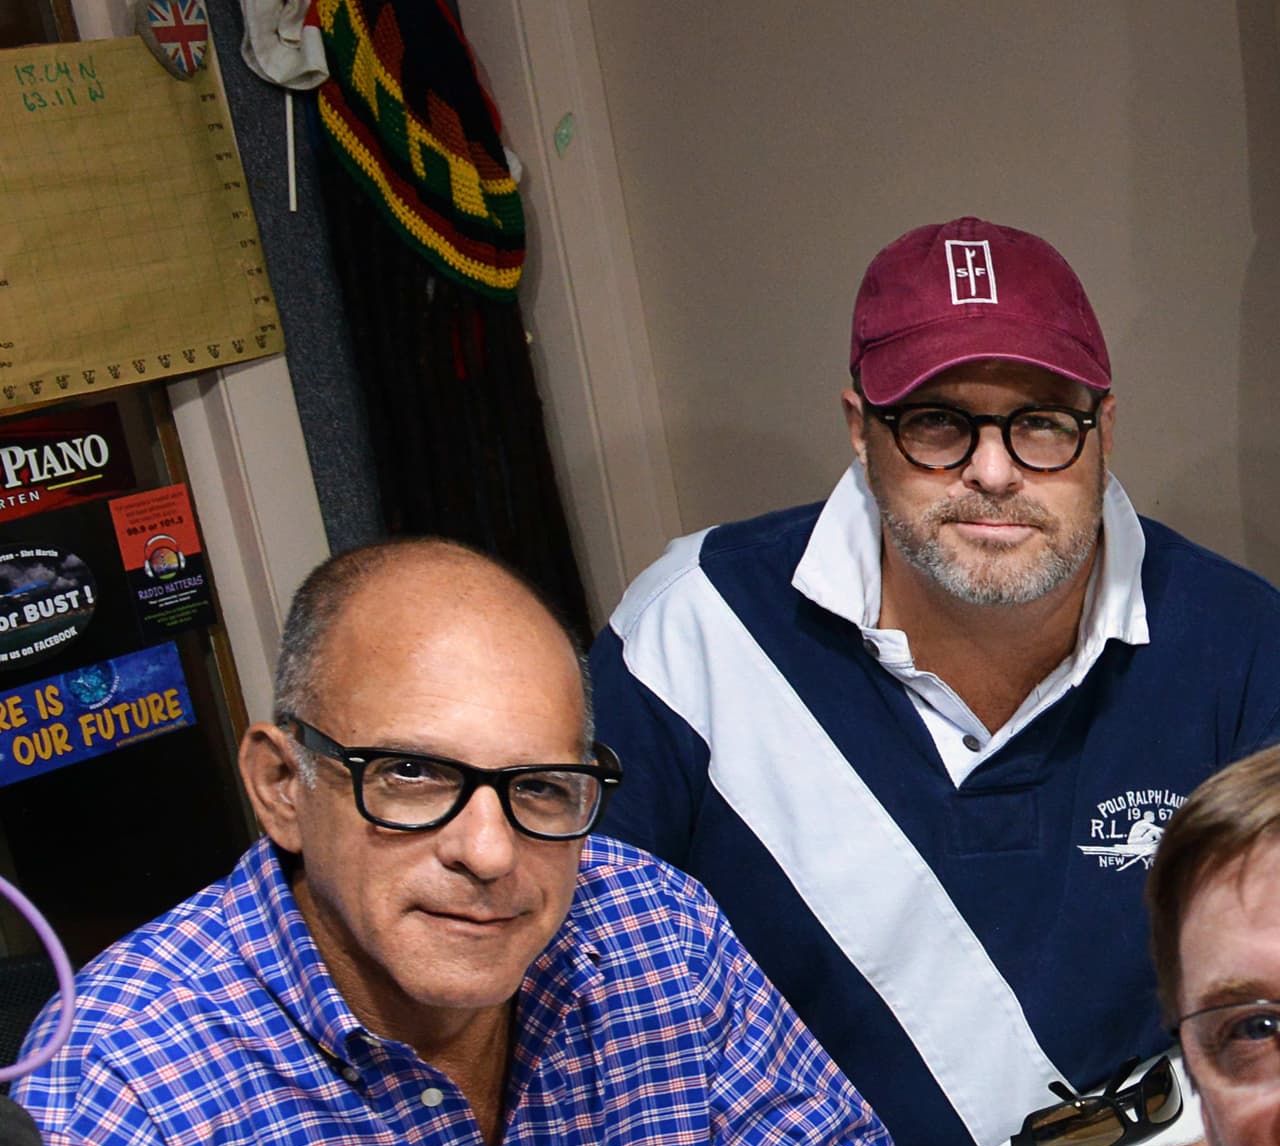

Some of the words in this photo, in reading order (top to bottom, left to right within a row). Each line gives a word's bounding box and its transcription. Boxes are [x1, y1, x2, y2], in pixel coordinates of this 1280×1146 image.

[1, 434, 109, 488] PIANO
[138, 586, 164, 600] RADIO
[165, 575, 203, 594] HATTERAS
[23, 590, 79, 623] BUST
[9, 651, 20, 659] us
[21, 647, 34, 656] on
[34, 626, 78, 653] FACEBOOK
[35, 685, 64, 720] IS
[12, 723, 73, 765] OUR
[78, 688, 183, 746] FUTURE
[1097, 796, 1127, 818] POLO
[1126, 790, 1162, 807] RALPH
[1164, 790, 1189, 809] LAU
[1128, 808, 1140, 820] 19
[1159, 808, 1173, 820] 67
[1091, 819, 1127, 839] R.L.
[1099, 854, 1125, 868] NEW
